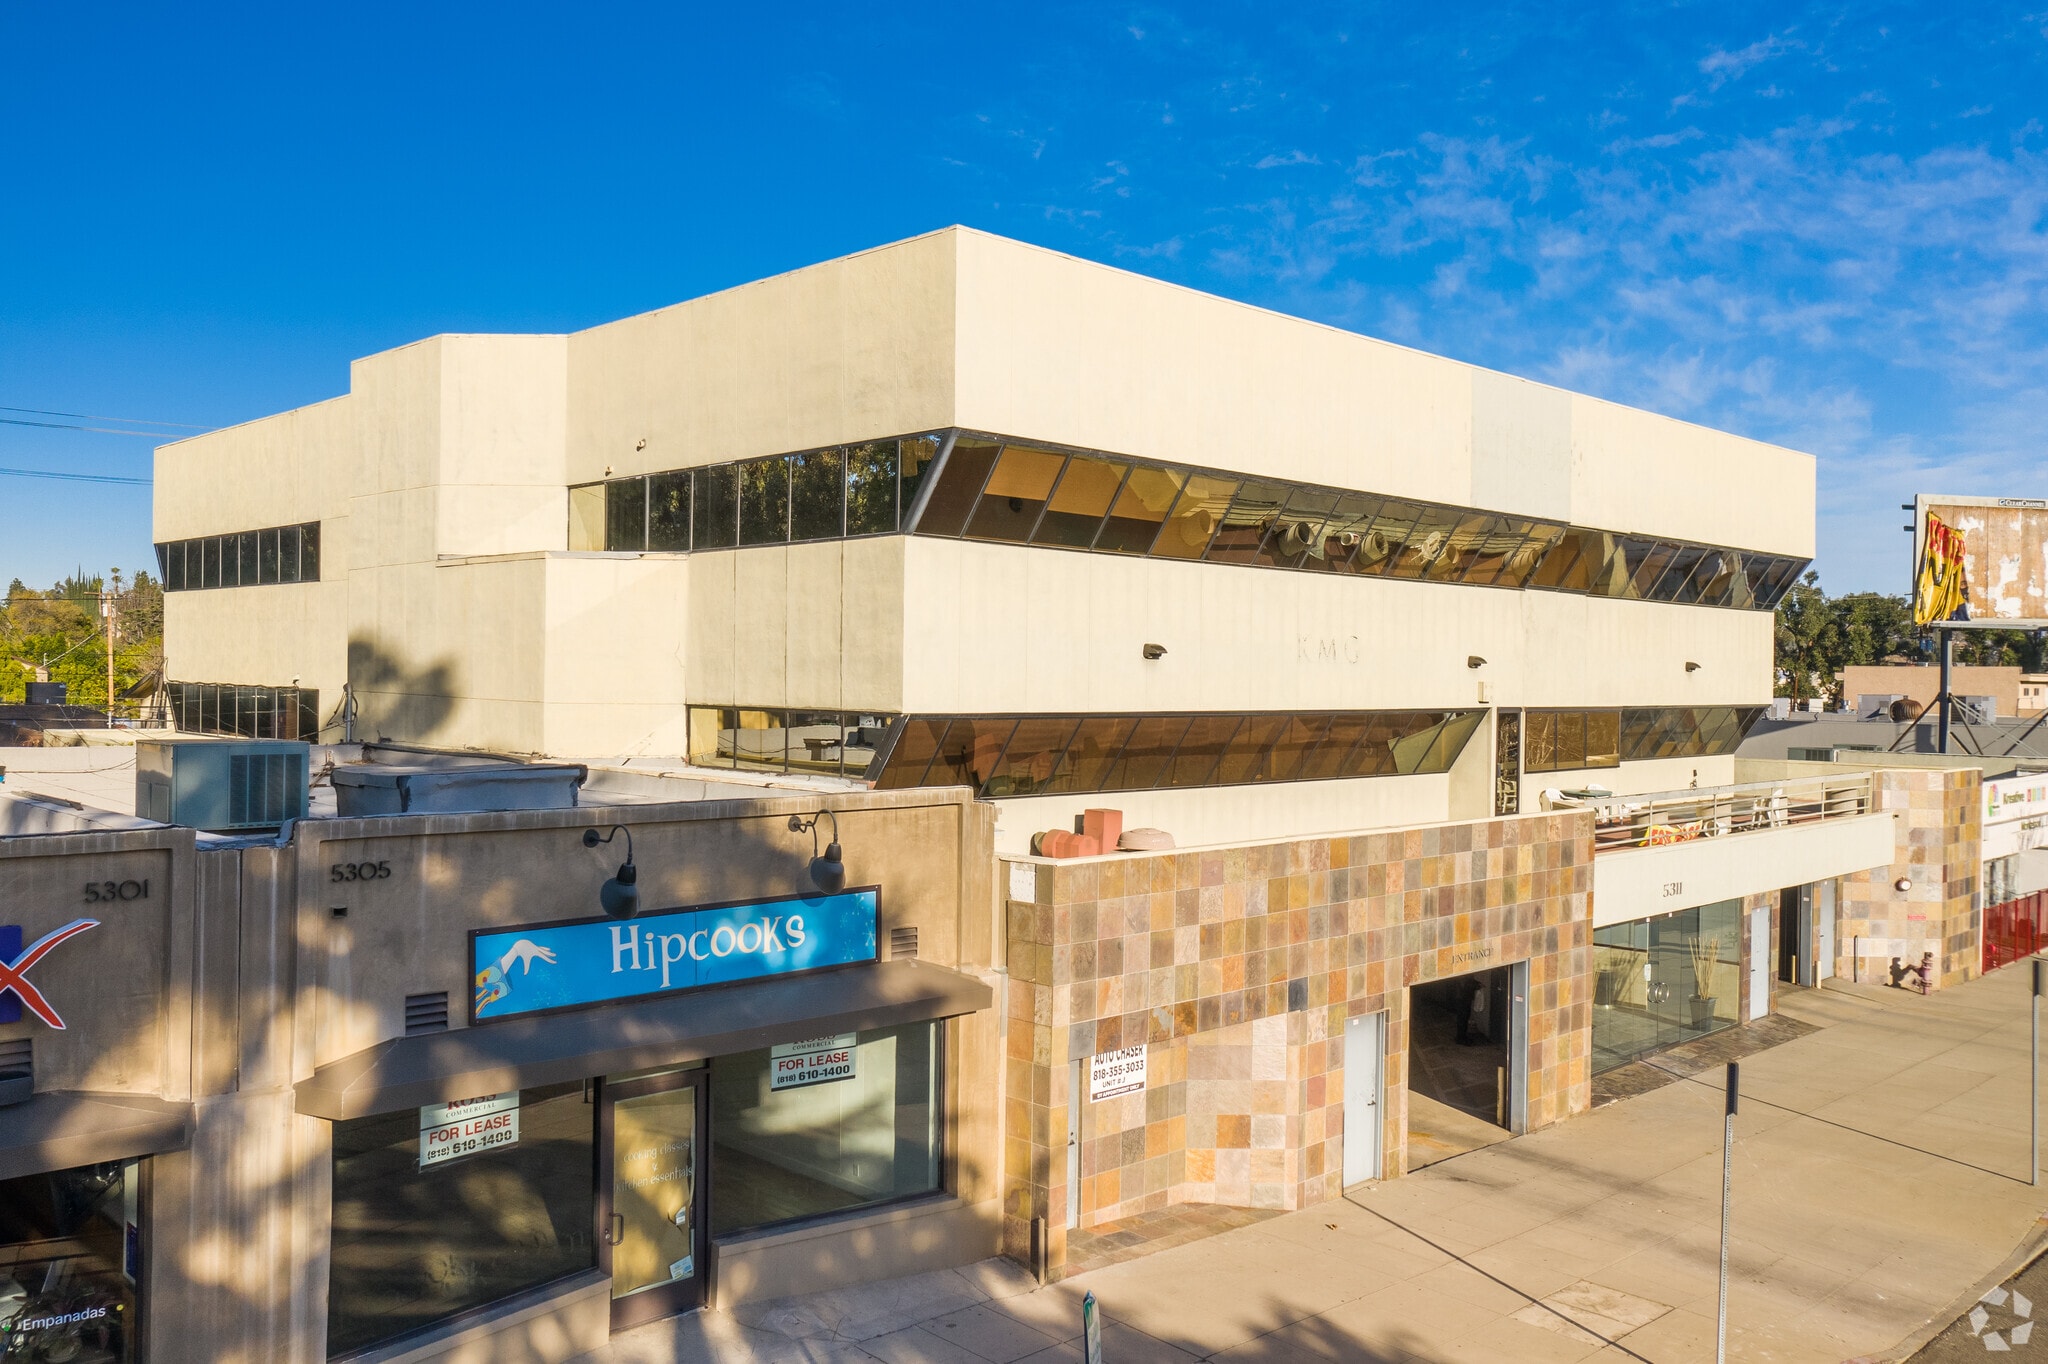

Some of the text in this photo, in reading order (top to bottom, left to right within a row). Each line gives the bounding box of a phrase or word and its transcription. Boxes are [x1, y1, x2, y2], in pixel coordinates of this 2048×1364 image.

[331, 860, 392, 884] 5305
[84, 879, 149, 904] 5301
[1662, 881, 1683, 898] 5311
[792, 1041, 836, 1051] COMMERCIAL
[778, 1051, 849, 1072] FOR LEASE
[1093, 1059, 1144, 1081] 818-355-3033
[777, 1064, 850, 1084] (818) 610-1400
[1102, 1079, 1116, 1088] UNIT
[445, 1103, 496, 1118] COMMERCIAL
[429, 1114, 511, 1145] FOR LEASE
[427, 1130, 512, 1160] (818) 610-1400
[22, 1307, 106, 1332] Empanadas
